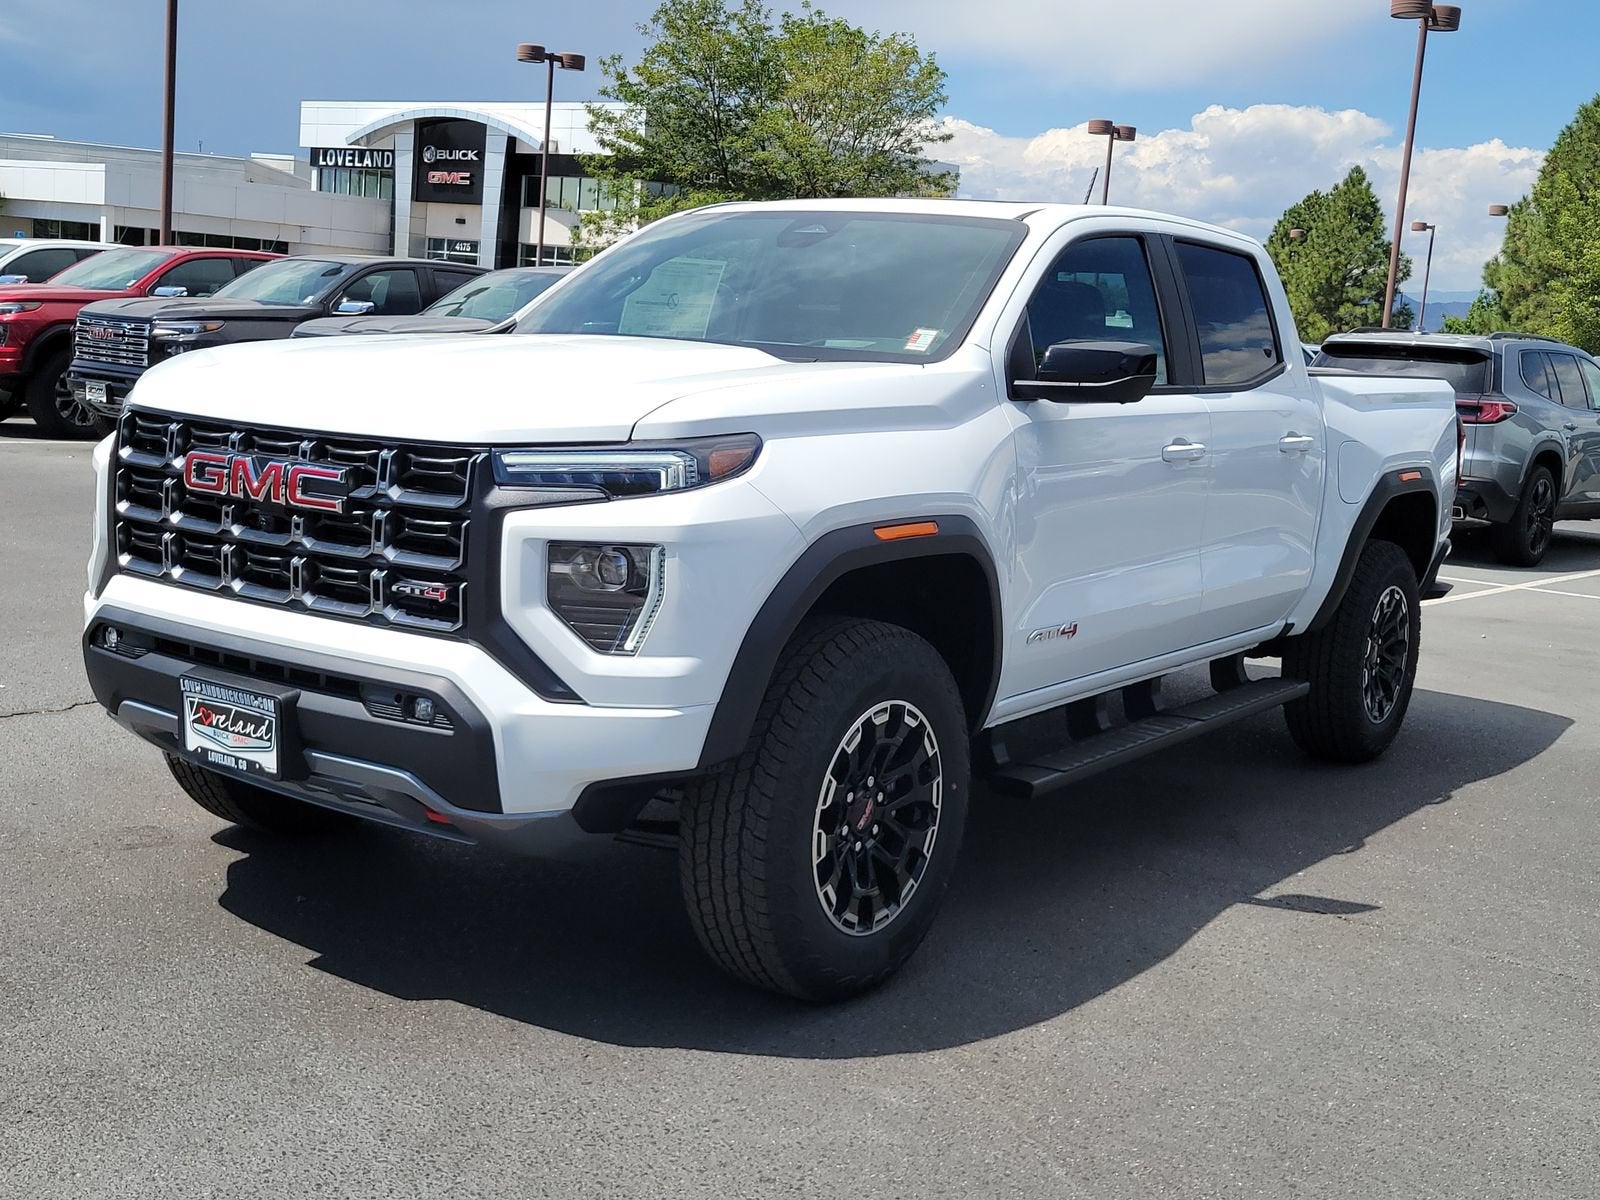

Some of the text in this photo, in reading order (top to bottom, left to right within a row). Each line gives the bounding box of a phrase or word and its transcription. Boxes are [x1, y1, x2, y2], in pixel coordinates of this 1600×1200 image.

[319, 149, 393, 167] LOVELAND
[436, 150, 479, 160] BUICK
[427, 171, 470, 185] GMC
[455, 242, 471, 251] 4175
[184, 451, 349, 513] GMC
[391, 582, 448, 602] AT4
[1026, 621, 1078, 644] AT4
[238, 759, 247, 771] CO
